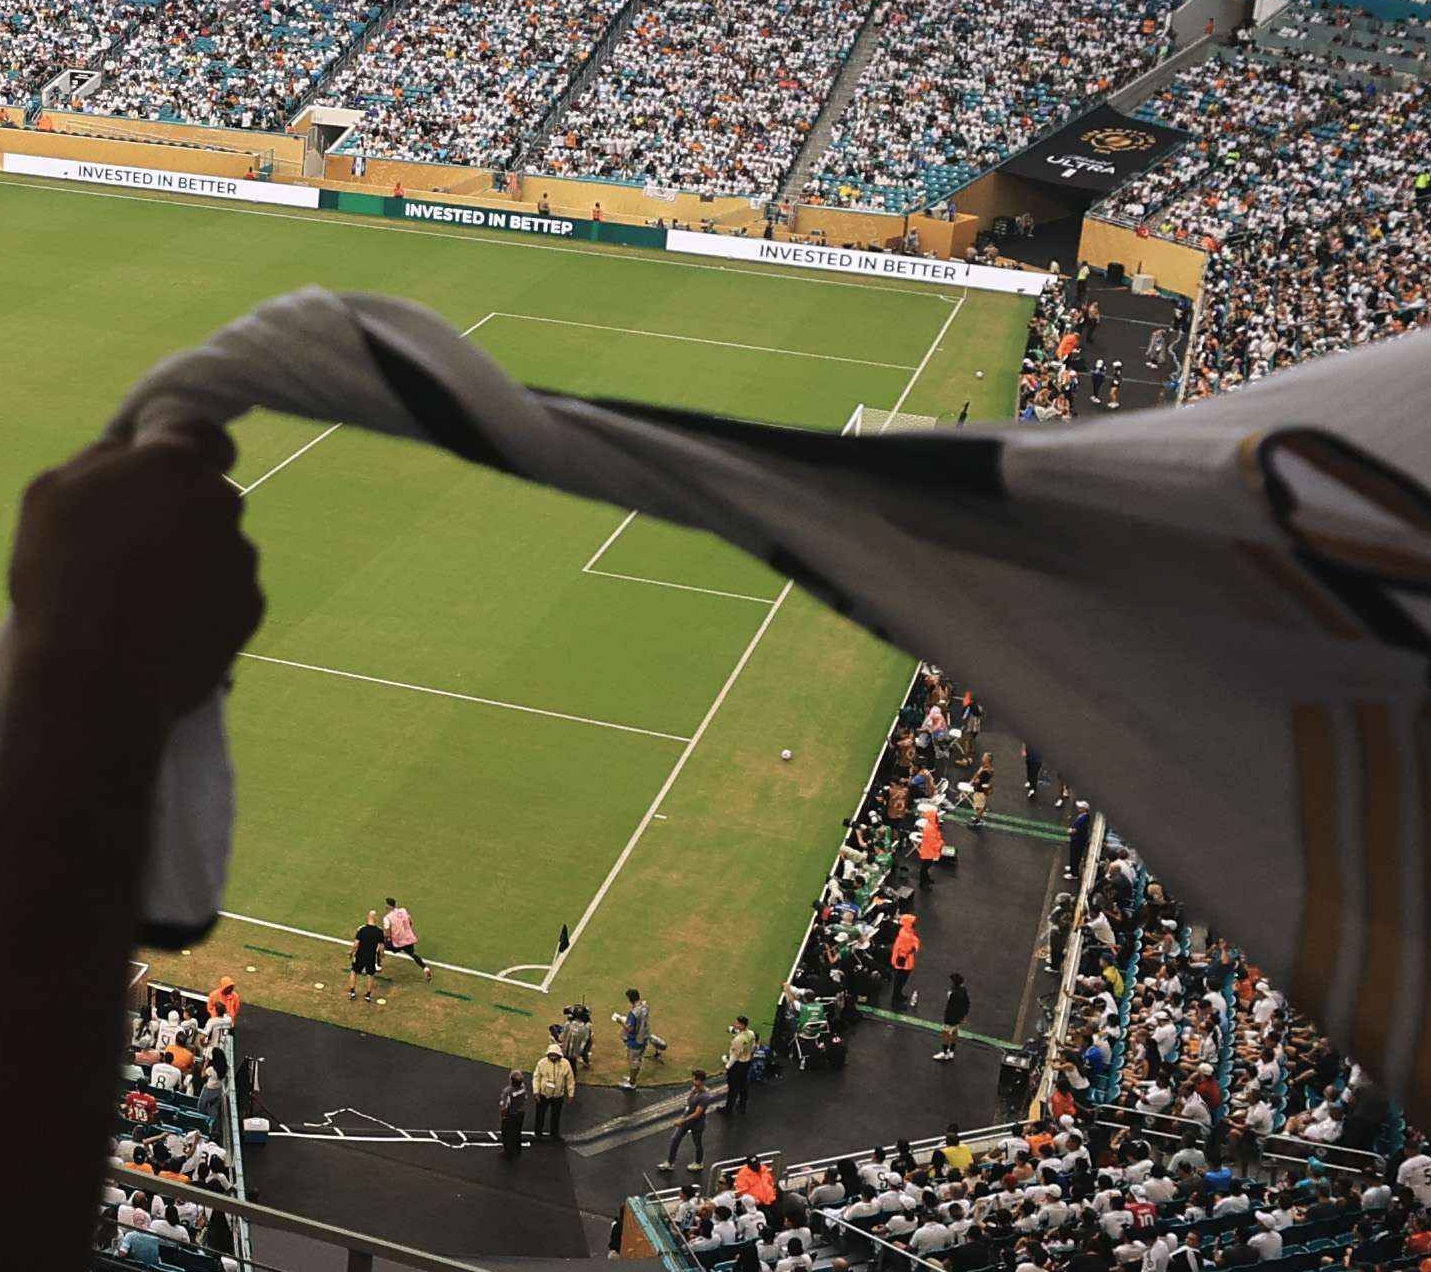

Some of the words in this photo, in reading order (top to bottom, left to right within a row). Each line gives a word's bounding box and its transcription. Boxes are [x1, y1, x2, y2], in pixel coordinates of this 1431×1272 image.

[78, 165, 154, 185] INVESTED
[157, 174, 174, 188] IN
[178, 176, 238, 194] BETTER
[1046, 155, 1116, 174] ULTRA
[405, 202, 485, 226] INVESTED
[488, 213, 506, 228] IN
[509, 215, 574, 236] BETTER
[759, 244, 853, 267] INVESTED
[858, 254, 878, 270] IN
[883, 260, 957, 281] BETTER
